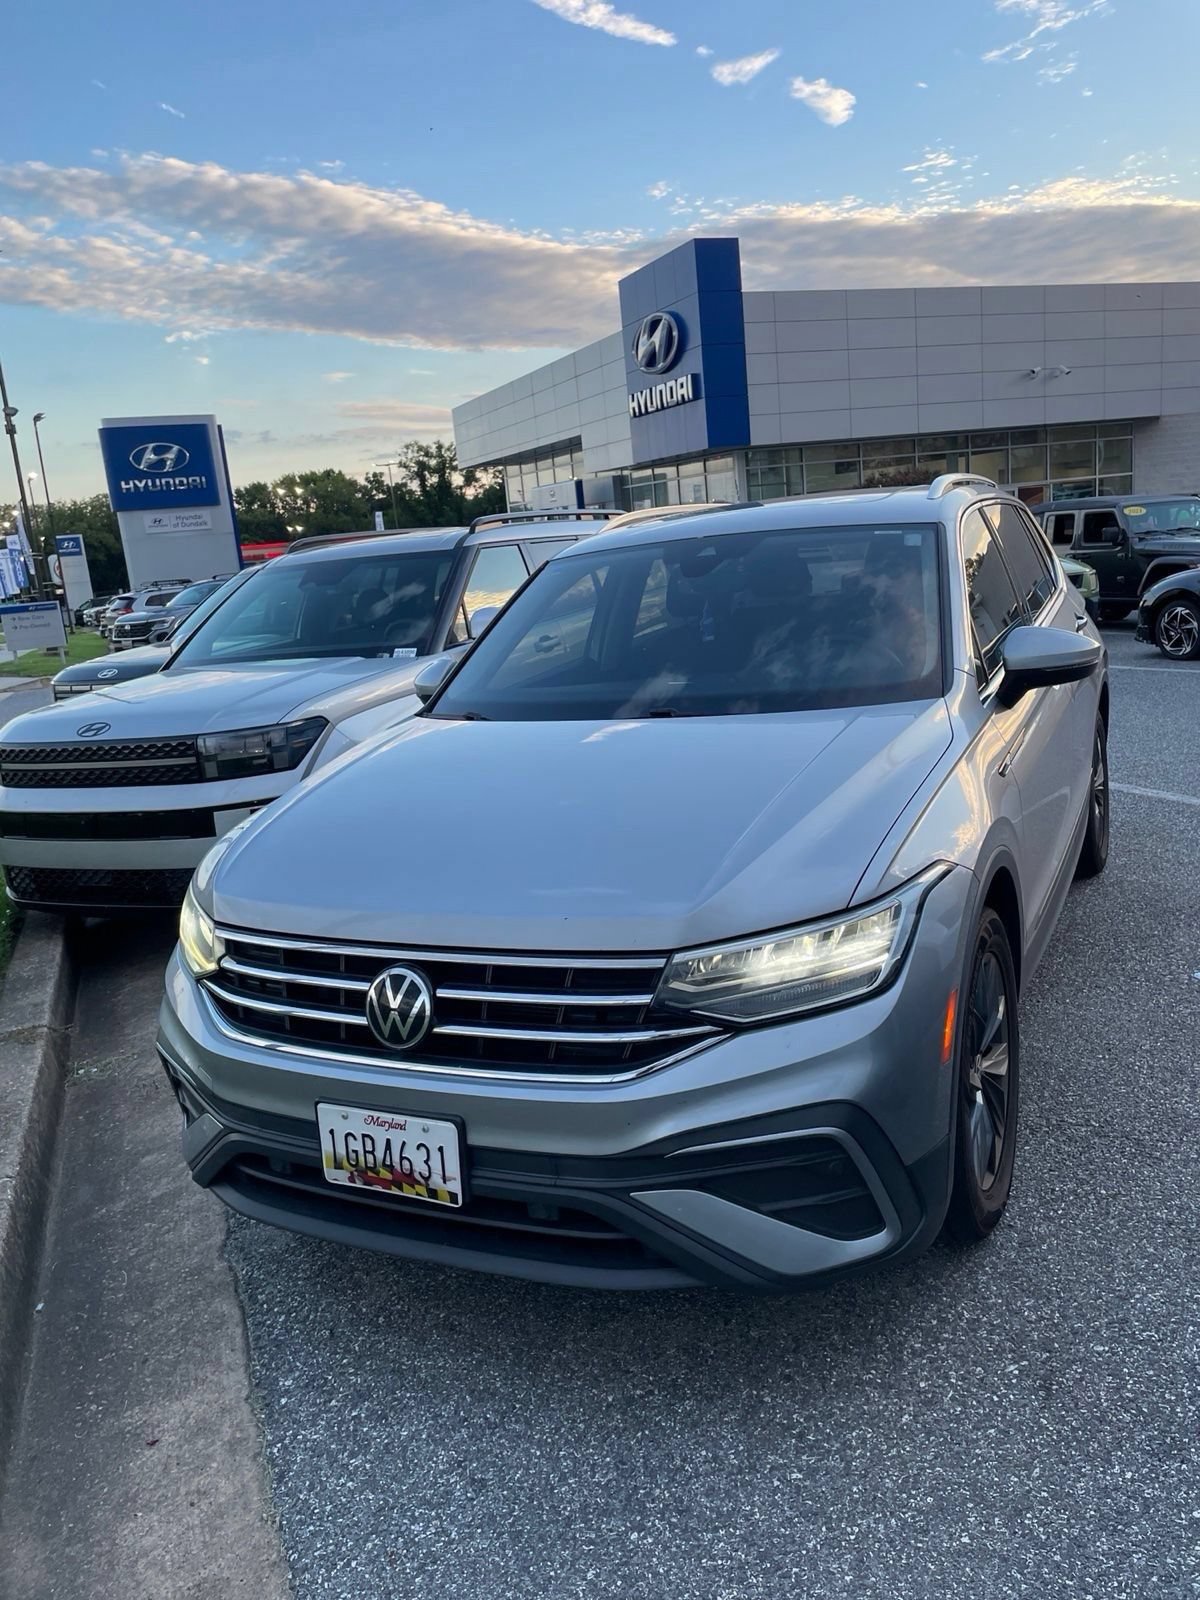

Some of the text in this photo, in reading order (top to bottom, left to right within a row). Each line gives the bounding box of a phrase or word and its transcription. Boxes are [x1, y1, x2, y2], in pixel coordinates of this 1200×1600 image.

[628, 373, 693, 418] HYUNDAI
[120, 475, 207, 493] HYUNDAI
[172, 521, 180, 529] of
[181, 519, 209, 528] Dundalk
[175, 514, 202, 523] Hyundai
[364, 1114, 407, 1132] Maryland
[328, 1128, 447, 1185] 1GB4631
